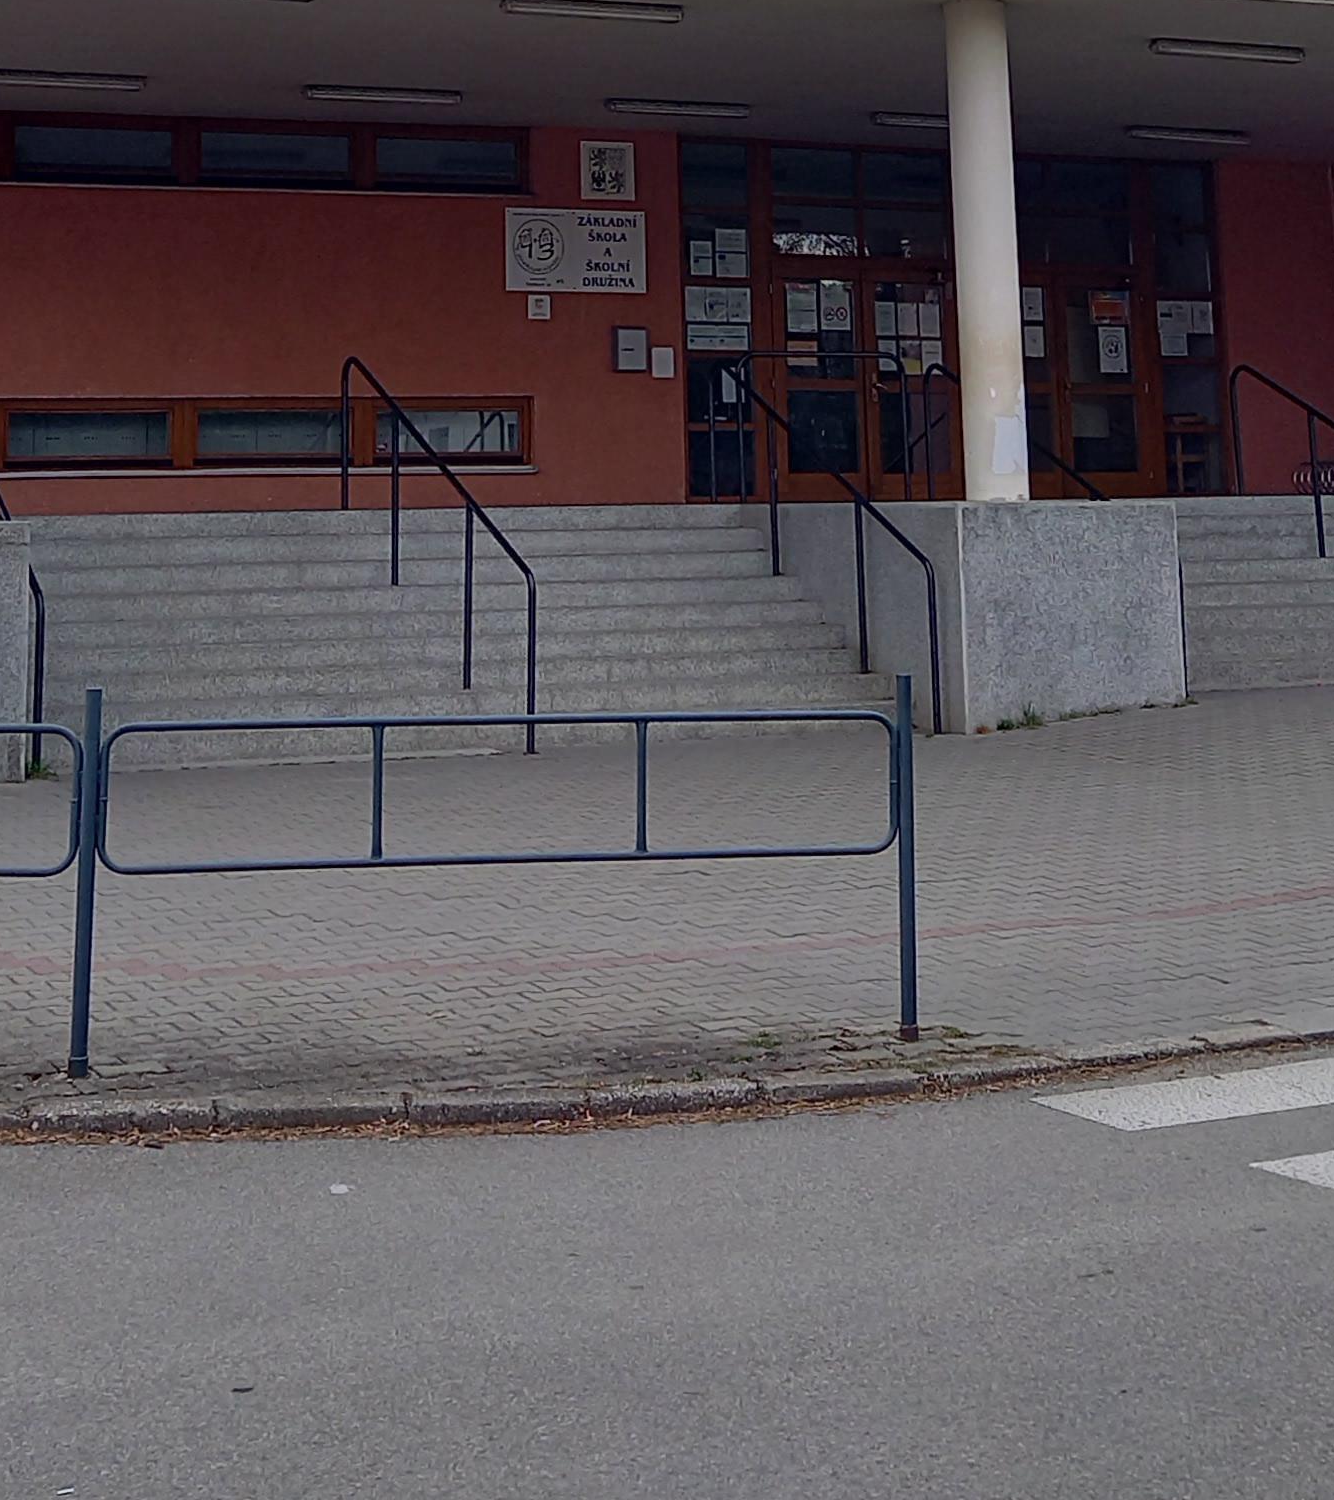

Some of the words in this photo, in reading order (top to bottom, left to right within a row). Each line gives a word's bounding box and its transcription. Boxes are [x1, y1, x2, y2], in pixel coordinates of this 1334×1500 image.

[577, 214, 637, 228] ZÁKLADNÍ
[588, 229, 627, 243] ŠKOLA
[603, 247, 612, 257] A
[585, 259, 630, 272] ŠKOLNÍ
[582, 275, 635, 288] DRUŽINA
